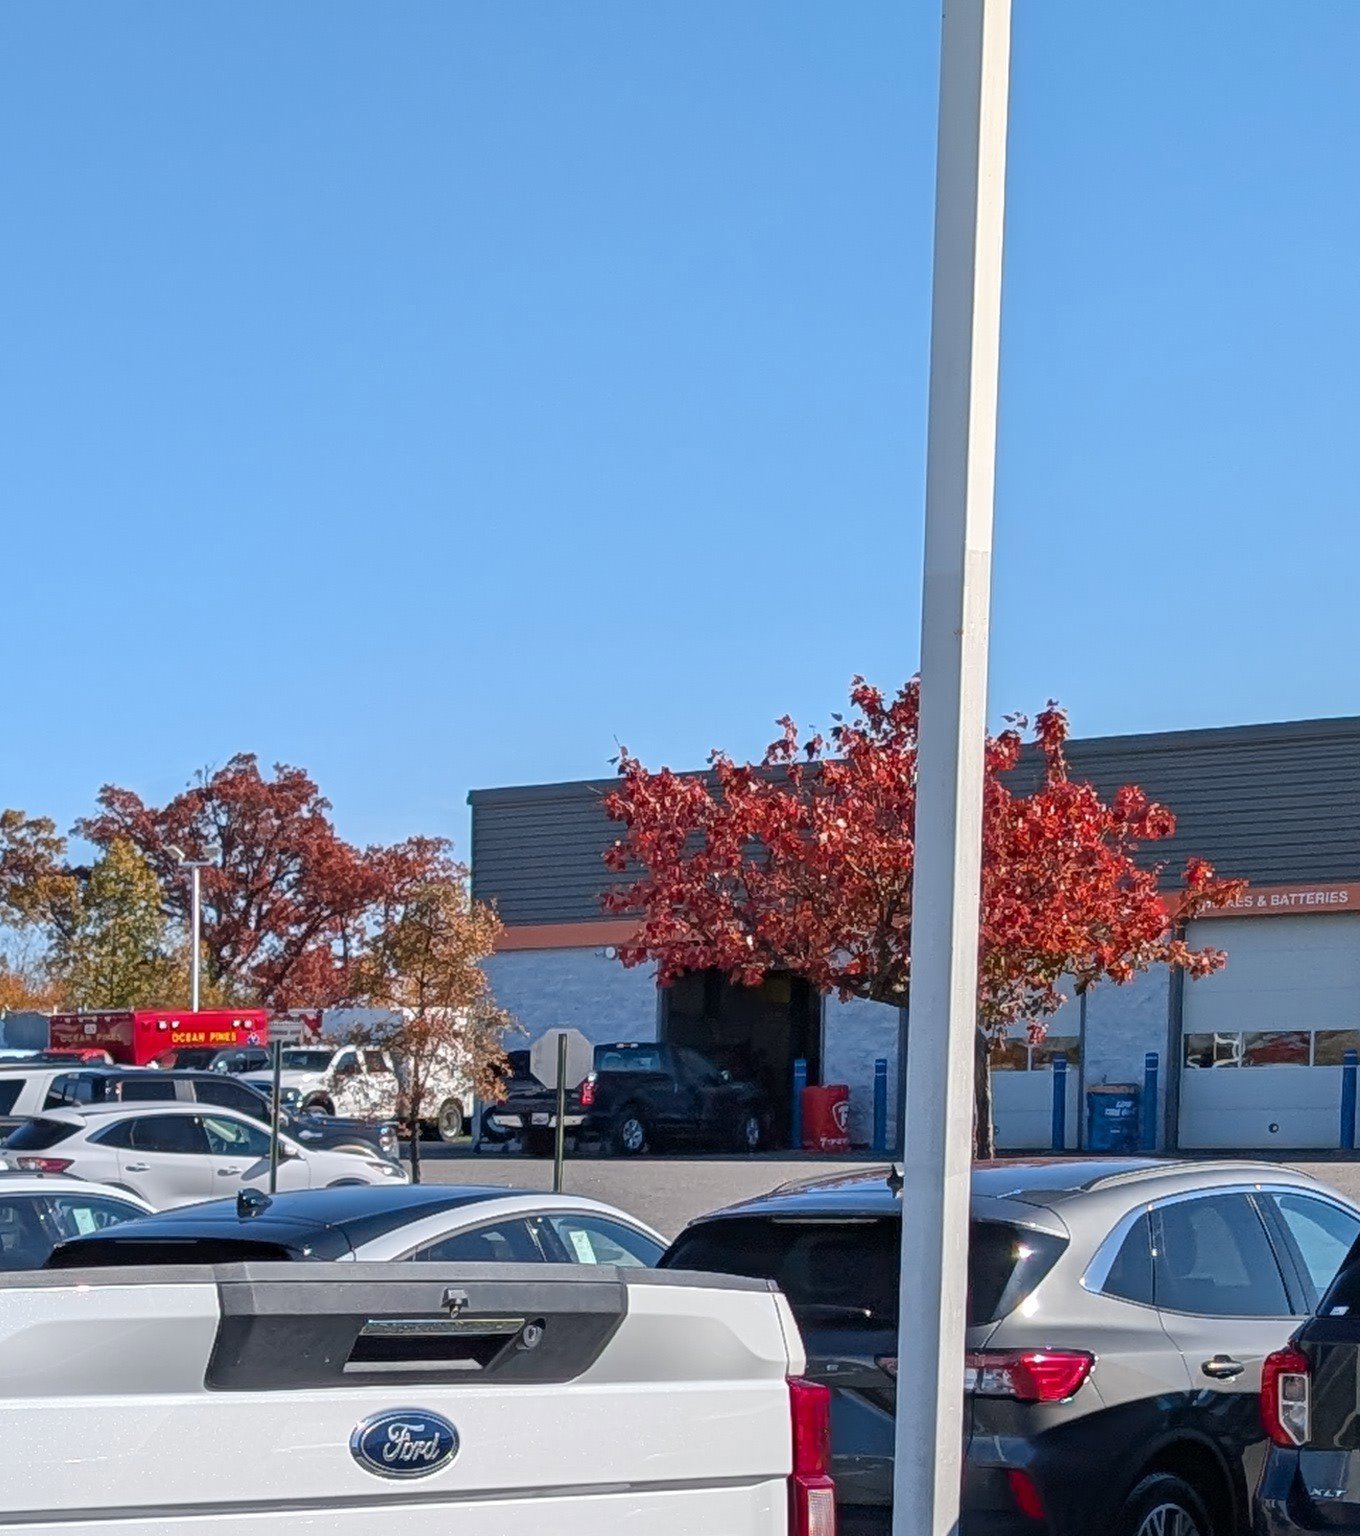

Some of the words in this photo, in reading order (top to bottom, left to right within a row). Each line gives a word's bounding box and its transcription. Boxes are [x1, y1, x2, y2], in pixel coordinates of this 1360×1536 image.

[1257, 894, 1268, 907] &
[1270, 890, 1349, 907] BATTERIES
[172, 1032, 206, 1043] OCEAN
[209, 1031, 237, 1042] PINES
[382, 1422, 440, 1462] Ford
[1309, 1487, 1347, 1498] XLT
